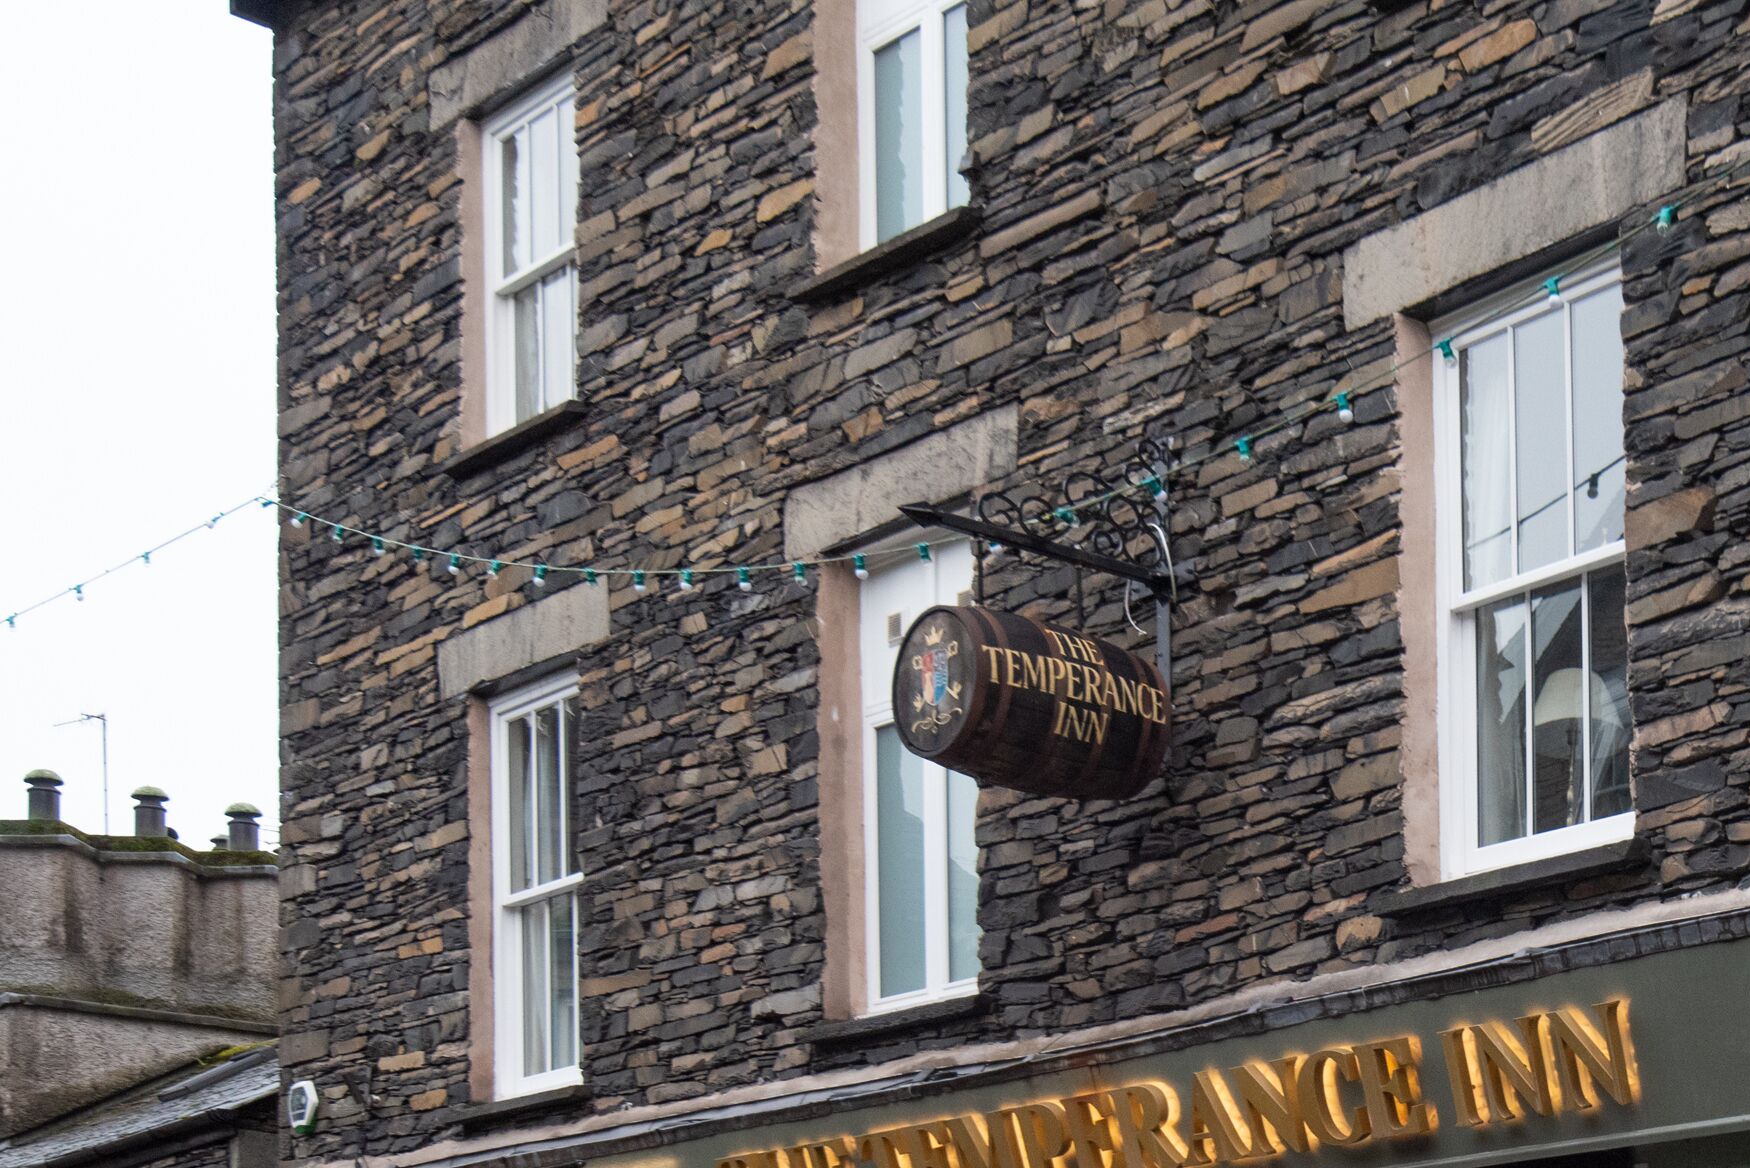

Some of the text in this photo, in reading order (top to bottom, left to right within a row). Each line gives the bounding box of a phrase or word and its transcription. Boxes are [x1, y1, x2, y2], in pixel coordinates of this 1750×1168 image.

[1045, 628, 1104, 666] THE
[981, 644, 1167, 724] TEMPERANCE
[1053, 701, 1109, 745] INN
[1436, 1000, 1640, 1129] INN
